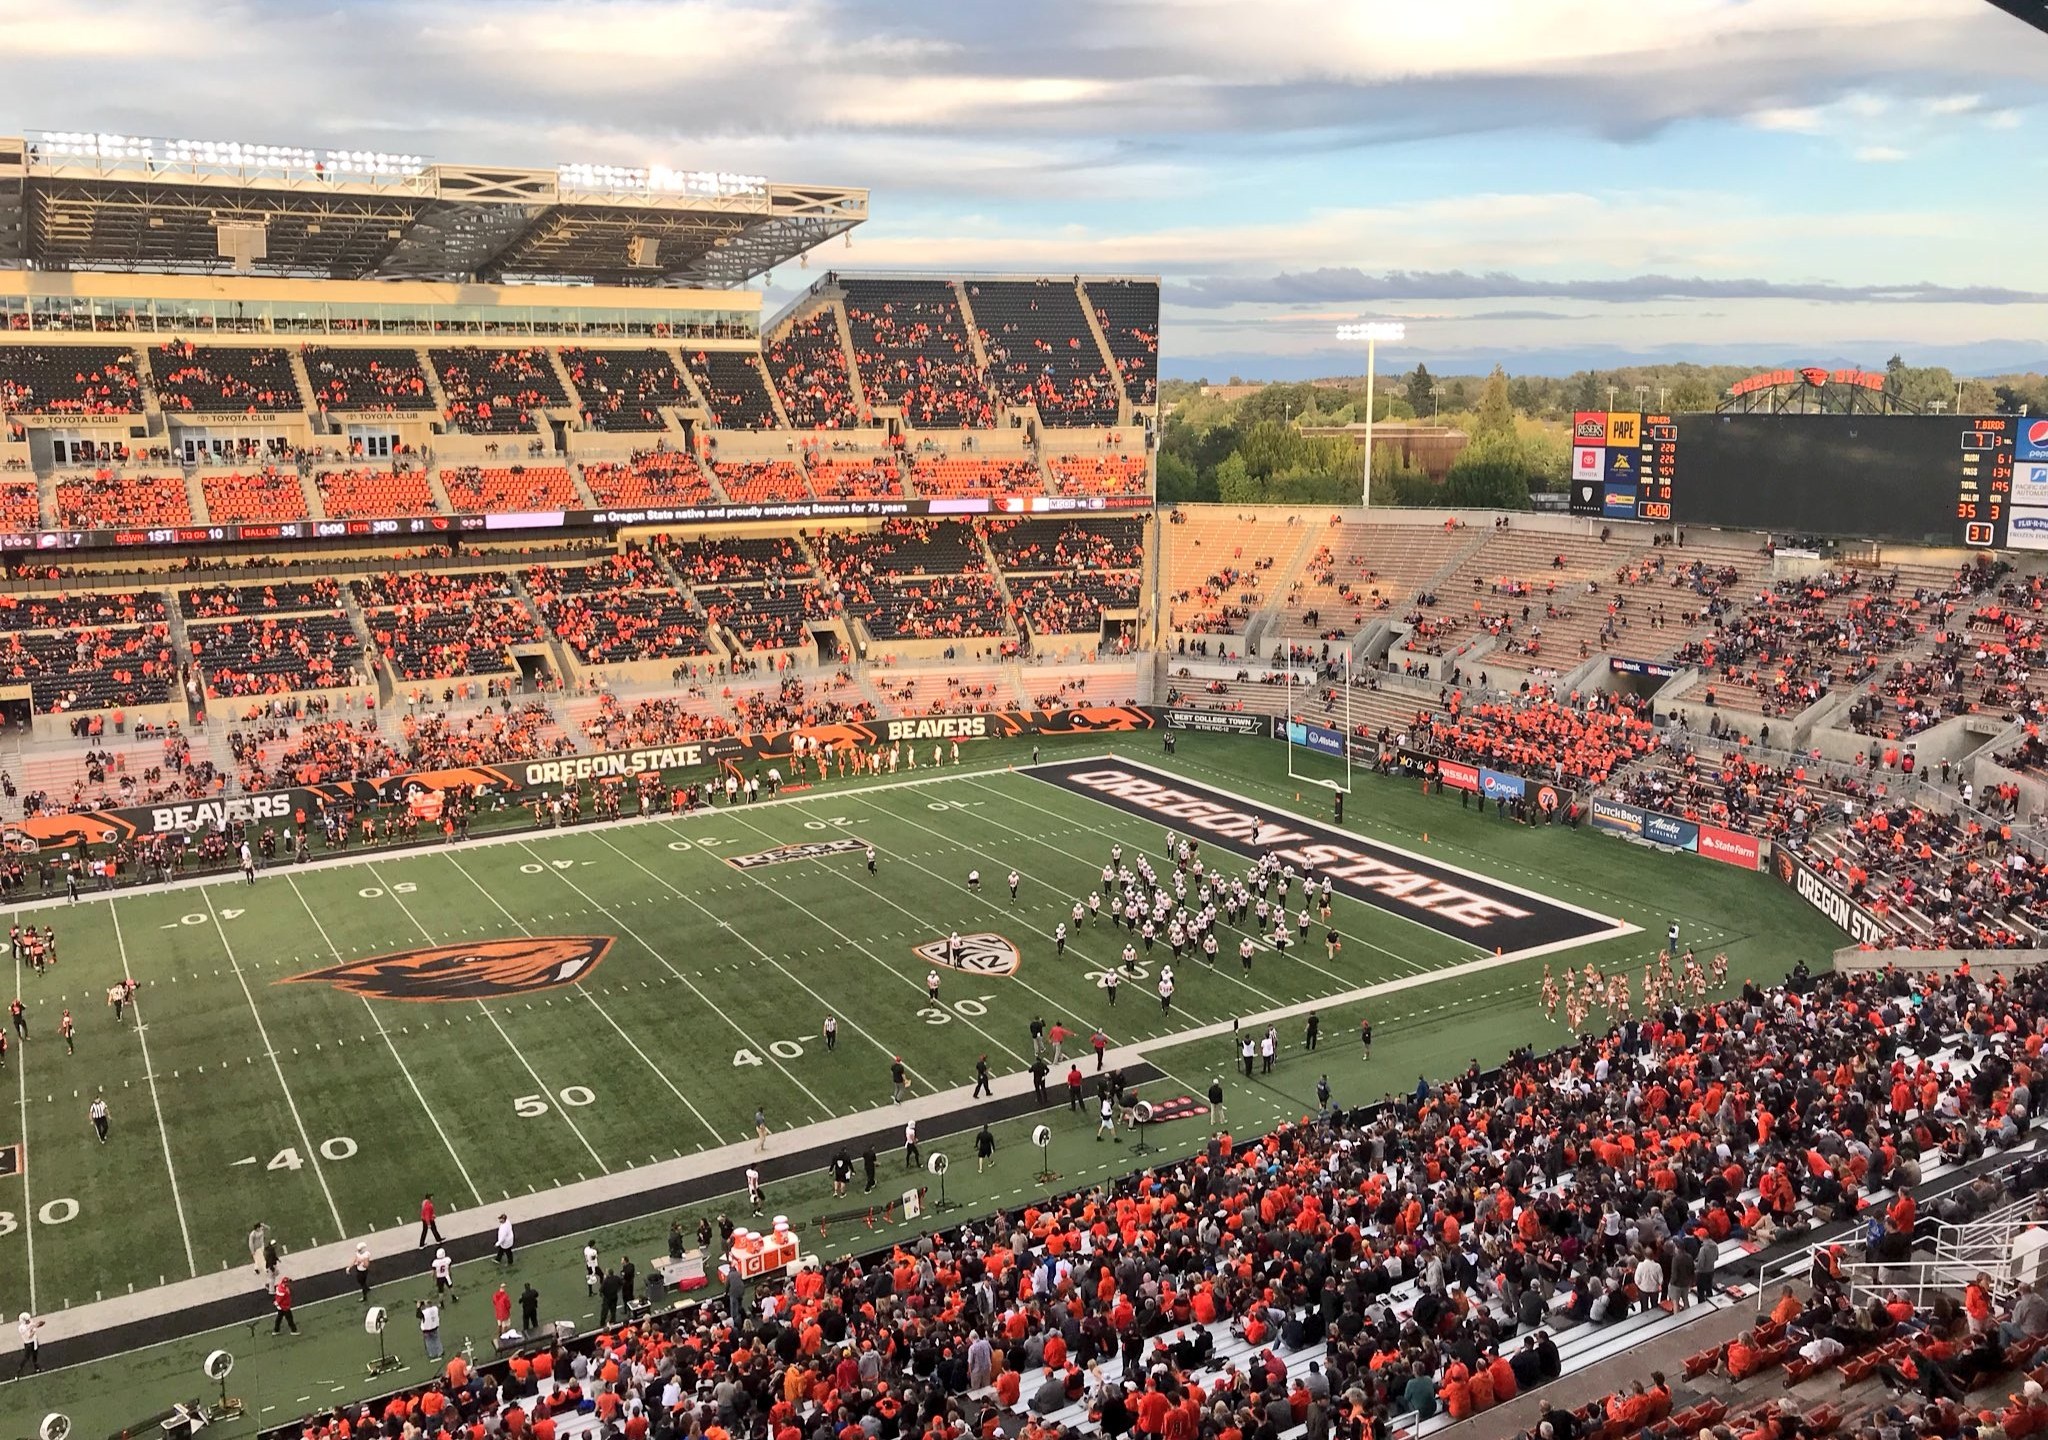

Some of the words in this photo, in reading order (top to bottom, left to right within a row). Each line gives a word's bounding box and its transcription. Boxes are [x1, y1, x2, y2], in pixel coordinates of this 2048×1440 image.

[1975, 421, 2005, 430] T.BIRDS
[1662, 428, 1675, 438] 41
[1976, 432, 1984, 446] 7
[1995, 436, 2002, 446] 3
[1660, 444, 1675, 452] 228
[1660, 455, 1674, 464] 226
[1998, 454, 2012, 464] 61
[1660, 467, 1674, 475] 454
[1963, 468, 1978, 476] PASS
[1993, 468, 2010, 477] 134
[1646, 486, 1650, 497] 1
[1961, 481, 1978, 490] TOTAL
[1992, 482, 2009, 492] 195
[1660, 487, 1671, 499] 10
[593, 514, 606, 522] an
[608, 512, 645, 524] Oregon
[646, 510, 673, 520] State
[675, 508, 705, 519] native
[707, 507, 725, 517] and
[727, 506, 762, 518] proudly
[764, 504, 810, 516] employing
[812, 504, 850, 514] Beavers
[851, 502, 866, 512] for
[868, 503, 880, 512] 75
[881, 504, 908, 514] years
[1646, 504, 1669, 517] 0:00
[1958, 504, 1976, 518] 35
[1991, 506, 2000, 520] 3
[245, 527, 266, 536] BALL
[268, 527, 278, 535] ON
[281, 524, 296, 536] 35
[320, 521, 346, 534] 0:00
[373, 520, 398, 532] 3RD
[410, 520, 424, 532] 41
[116, 534, 144, 542] DOWN
[148, 530, 172, 542] 1ST
[181, 532, 193, 540] TO
[209, 528, 224, 540] 10
[1970, 526, 1990, 540] 31
[73, 534, 82, 546] 7
[1194, 715, 1227, 724] COLLEGE
[1228, 718, 1251, 726] TOWN
[888, 717, 985, 740] BEAVERS
[1318, 736, 1339, 748] Allstate
[526, 752, 630, 786] OREGON
[631, 745, 701, 772] STATE
[1438, 768, 1477, 785] NISSAN
[1496, 784, 1518, 795] pepsi
[1542, 794, 1554, 804] 76
[152, 794, 290, 832] BEAVERS
[1594, 802, 1621, 819] DUTCH
[1621, 809, 1642, 824] BROS
[1649, 818, 1680, 833] Alaska
[1650, 829, 1677, 840] AIRLINES
[1067, 770, 1315, 846] OREGON
[1275, 844, 1536, 928] STATE
[1797, 867, 1850, 931] OREGON
[1851, 910, 1888, 944] STA
[1084, 964, 1150, 988] 20
[916, 1000, 988, 1025] 30
[732, 1040, 804, 1068] 40
[514, 1085, 596, 1118] 50
[266, 1136, 358, 1172] 40
[440, 1265, 446, 1273] 6
[750, 1256, 761, 1270] G
[1166, 1310, 1174, 1322] 19
